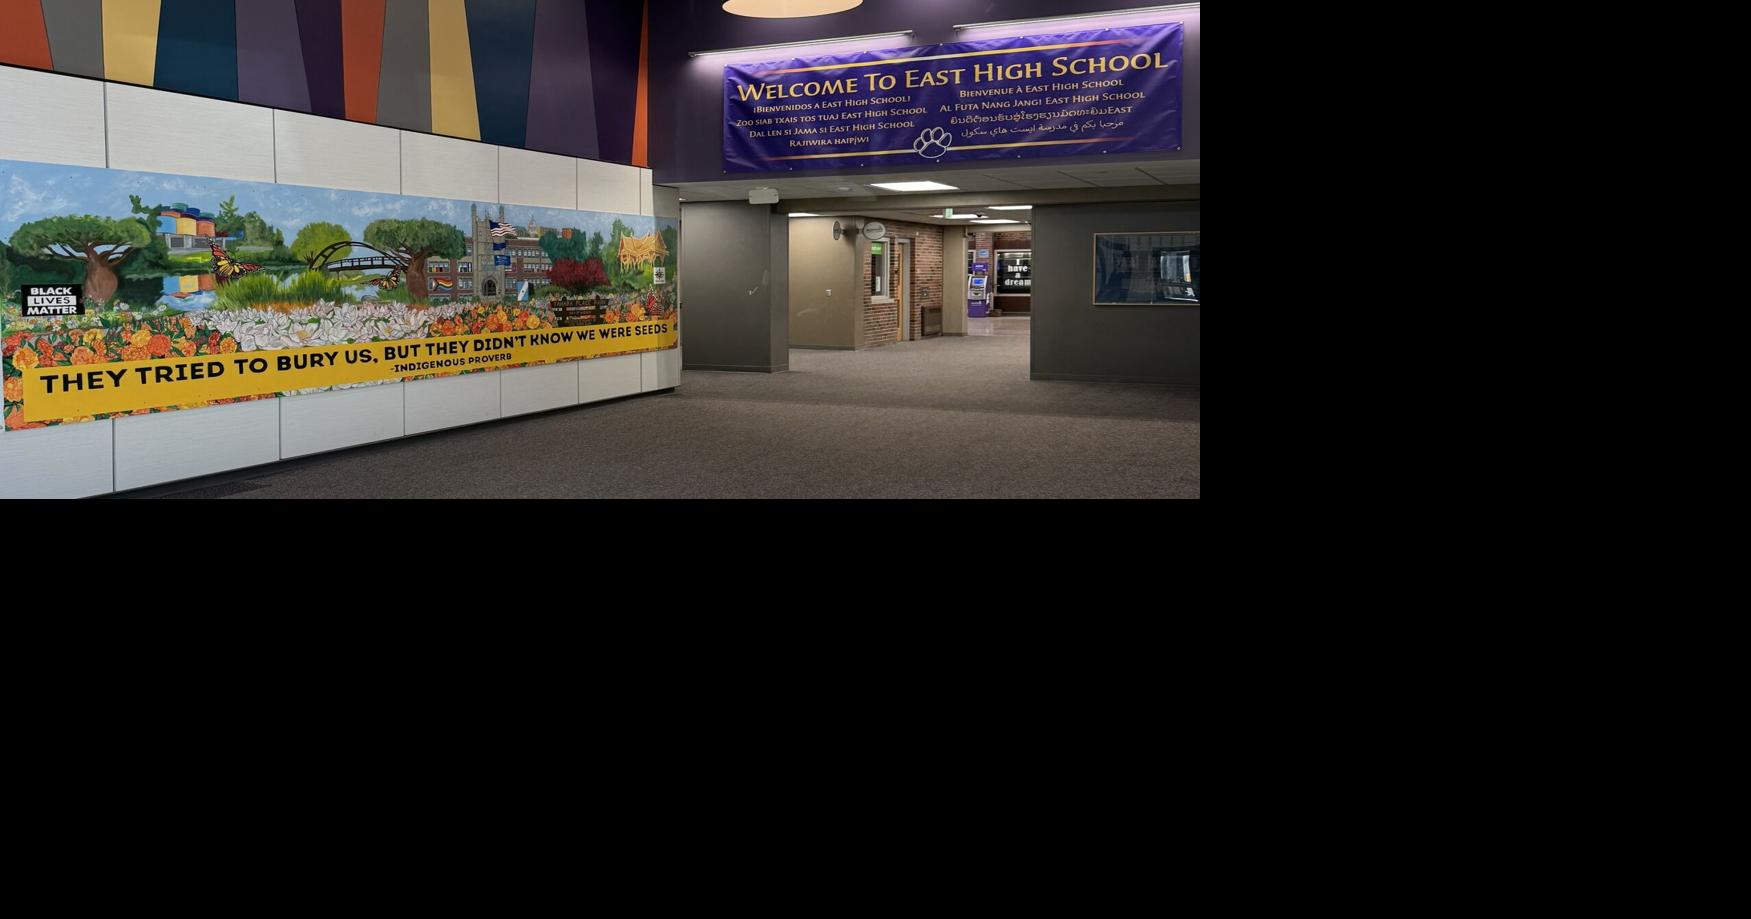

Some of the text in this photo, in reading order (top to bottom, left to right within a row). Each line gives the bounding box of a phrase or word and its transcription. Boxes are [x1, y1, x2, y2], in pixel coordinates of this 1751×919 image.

[737, 52, 1169, 101] WELCOME TO EAST HIGH SCHOOL
[959, 79, 1124, 98] BIENVENUE À EAST HIGH SCHOOL
[822, 100, 842, 109] EAST
[845, 98, 868, 107] HIGH
[940, 104, 952, 112] AL
[955, 103, 979, 111] FUTA
[981, 101, 1010, 109] NANG
[1045, 97, 1070, 105] EAST
[1072, 95, 1099, 103] HIGH
[1102, 92, 1146, 101] SCHOOL
[736, 119, 754, 127] ZOO
[755, 117, 772, 126] SIAB
[775, 116, 797, 124] TXAIS
[800, 115, 816, 123] TOS
[841, 111, 862, 120] EAST
[864, 109, 887, 118] HIGH
[890, 107, 928, 116] SCHOOL
[750, 130, 765, 138] DAL
[767, 129, 782, 137] LEN
[792, 126, 817, 136] JAMA
[829, 125, 850, 133] EAST
[852, 123, 875, 131] HIGH
[878, 121, 915, 130] SCHOOL
[30, 287, 72, 295] BLACK
[33, 297, 71, 305] LIVES
[27, 306, 78, 315] MATTER
[40, 323, 668, 394] THEY TRIED TO BURY US, BUT THEY DIDN’T KNOW WE WERE SEEDS
[468, 353, 512, 364] PROVERB
